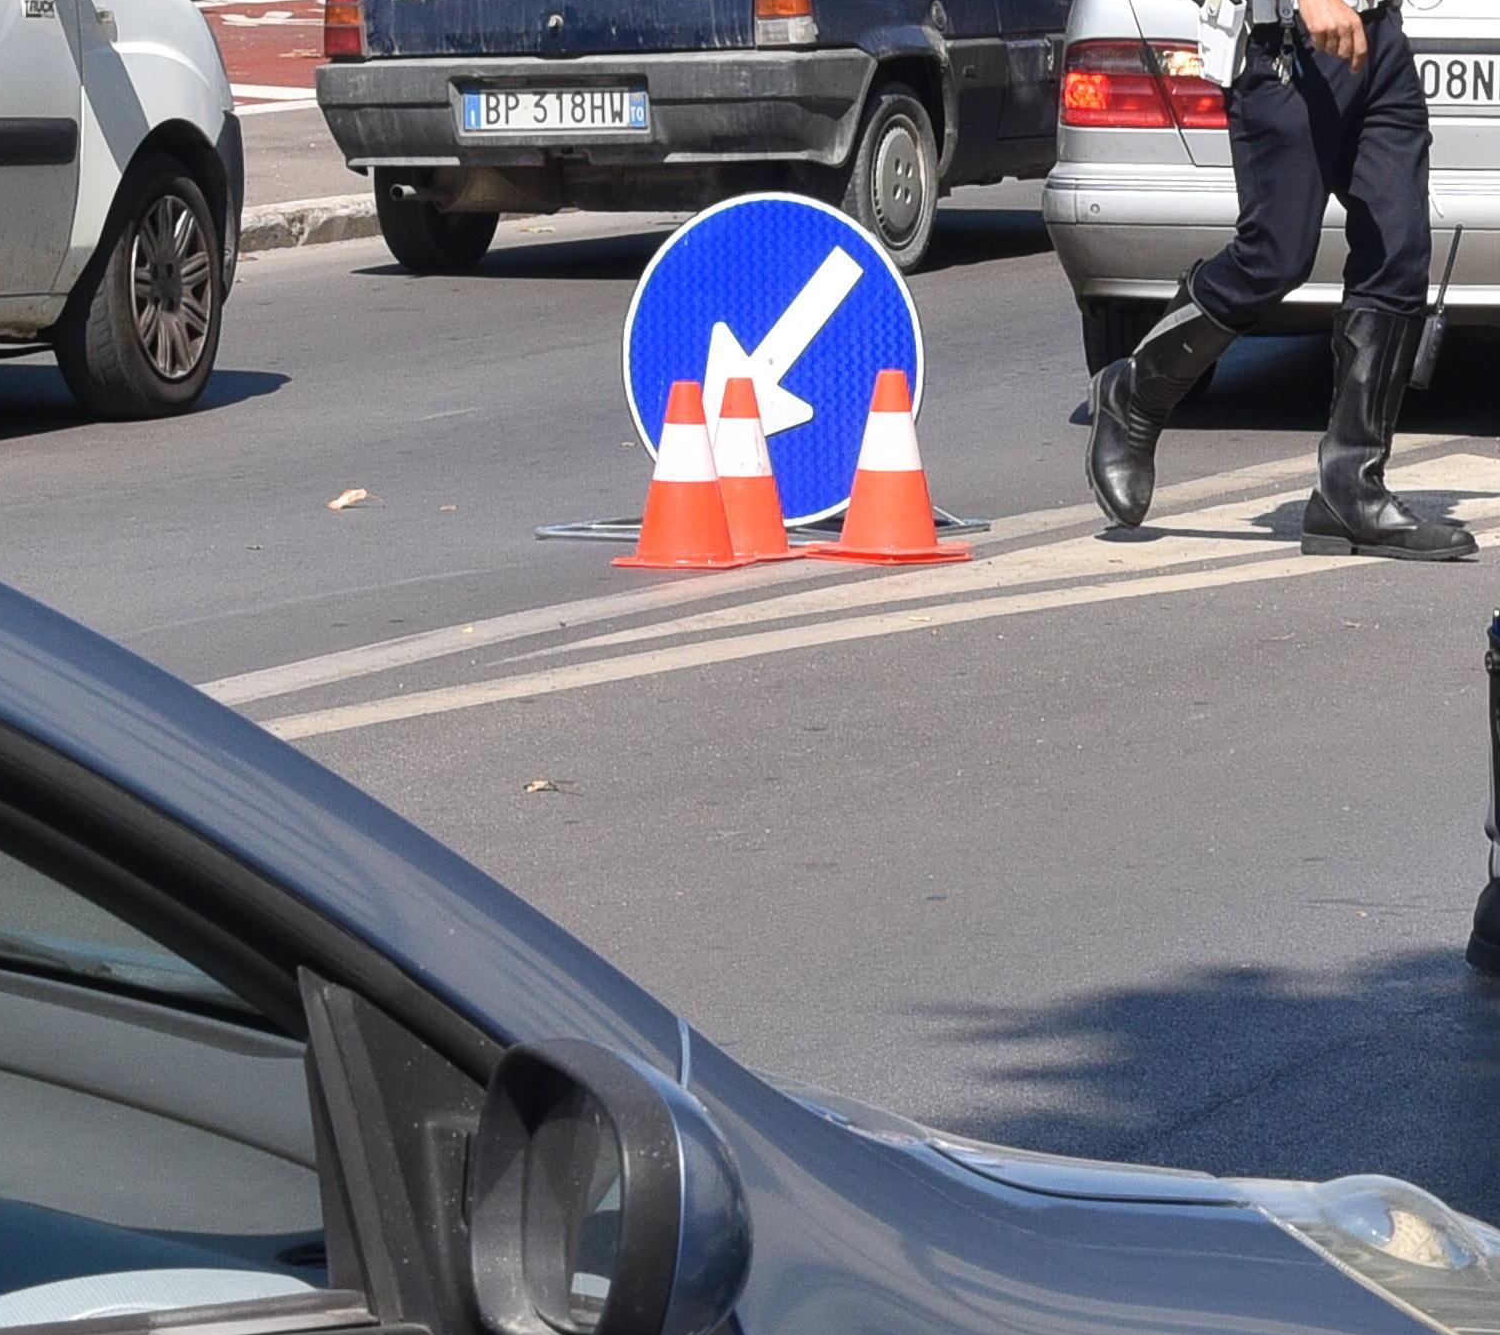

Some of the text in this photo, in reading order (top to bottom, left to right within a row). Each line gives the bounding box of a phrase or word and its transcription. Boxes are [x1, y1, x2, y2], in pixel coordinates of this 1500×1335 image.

[485, 91, 520, 124] BP
[533, 90, 625, 123] 318HW
[630, 106, 645, 117] TO
